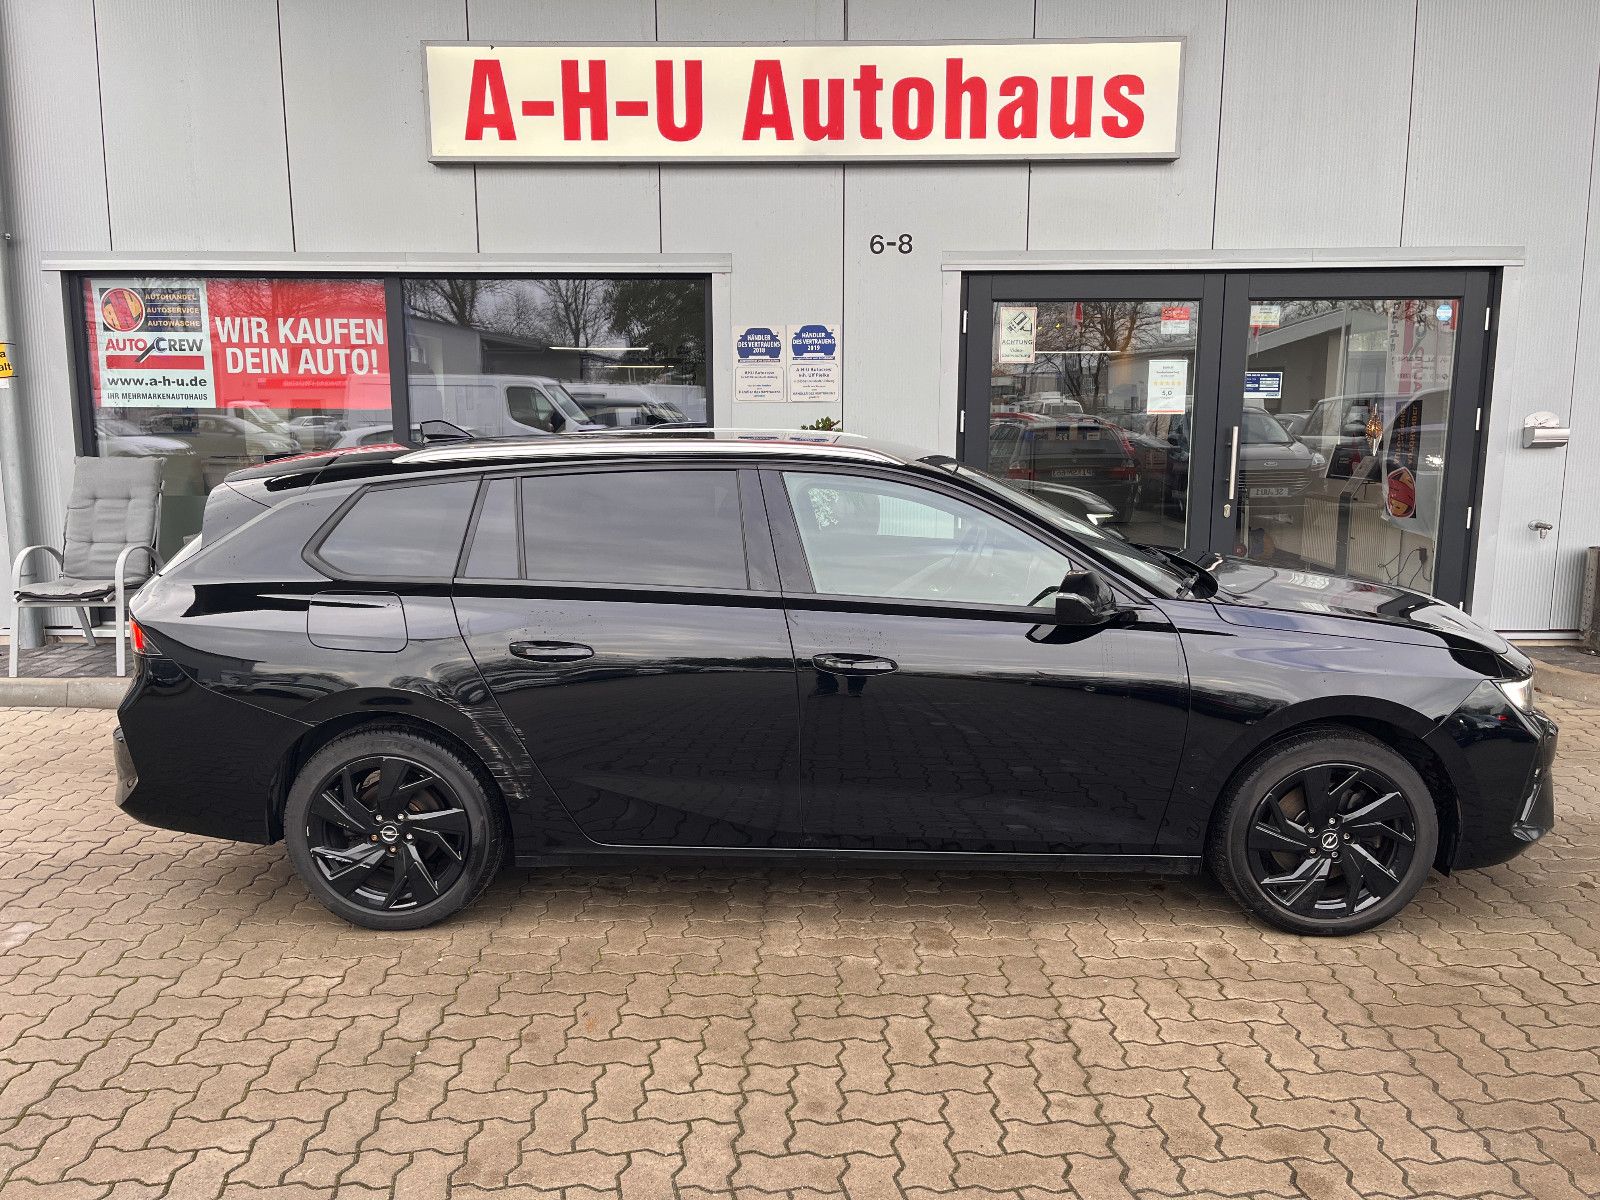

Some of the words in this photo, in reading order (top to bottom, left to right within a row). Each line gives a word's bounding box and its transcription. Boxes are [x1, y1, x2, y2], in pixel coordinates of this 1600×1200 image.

[465, 60, 702, 141] A-H-U
[743, 58, 1144, 141] Autohaus
[869, 234, 912, 254] 6-8
[145, 293, 197, 301] AUTOHANDEL
[215, 317, 270, 344] WIR
[277, 317, 385, 345] KAUFEN
[225, 347, 290, 374] DEIN
[297, 348, 380, 375] AUTO!
[107, 376, 208, 387] www.a-h-u.de
[121, 393, 208, 401] MEHRMARKENAUTOHAUS
